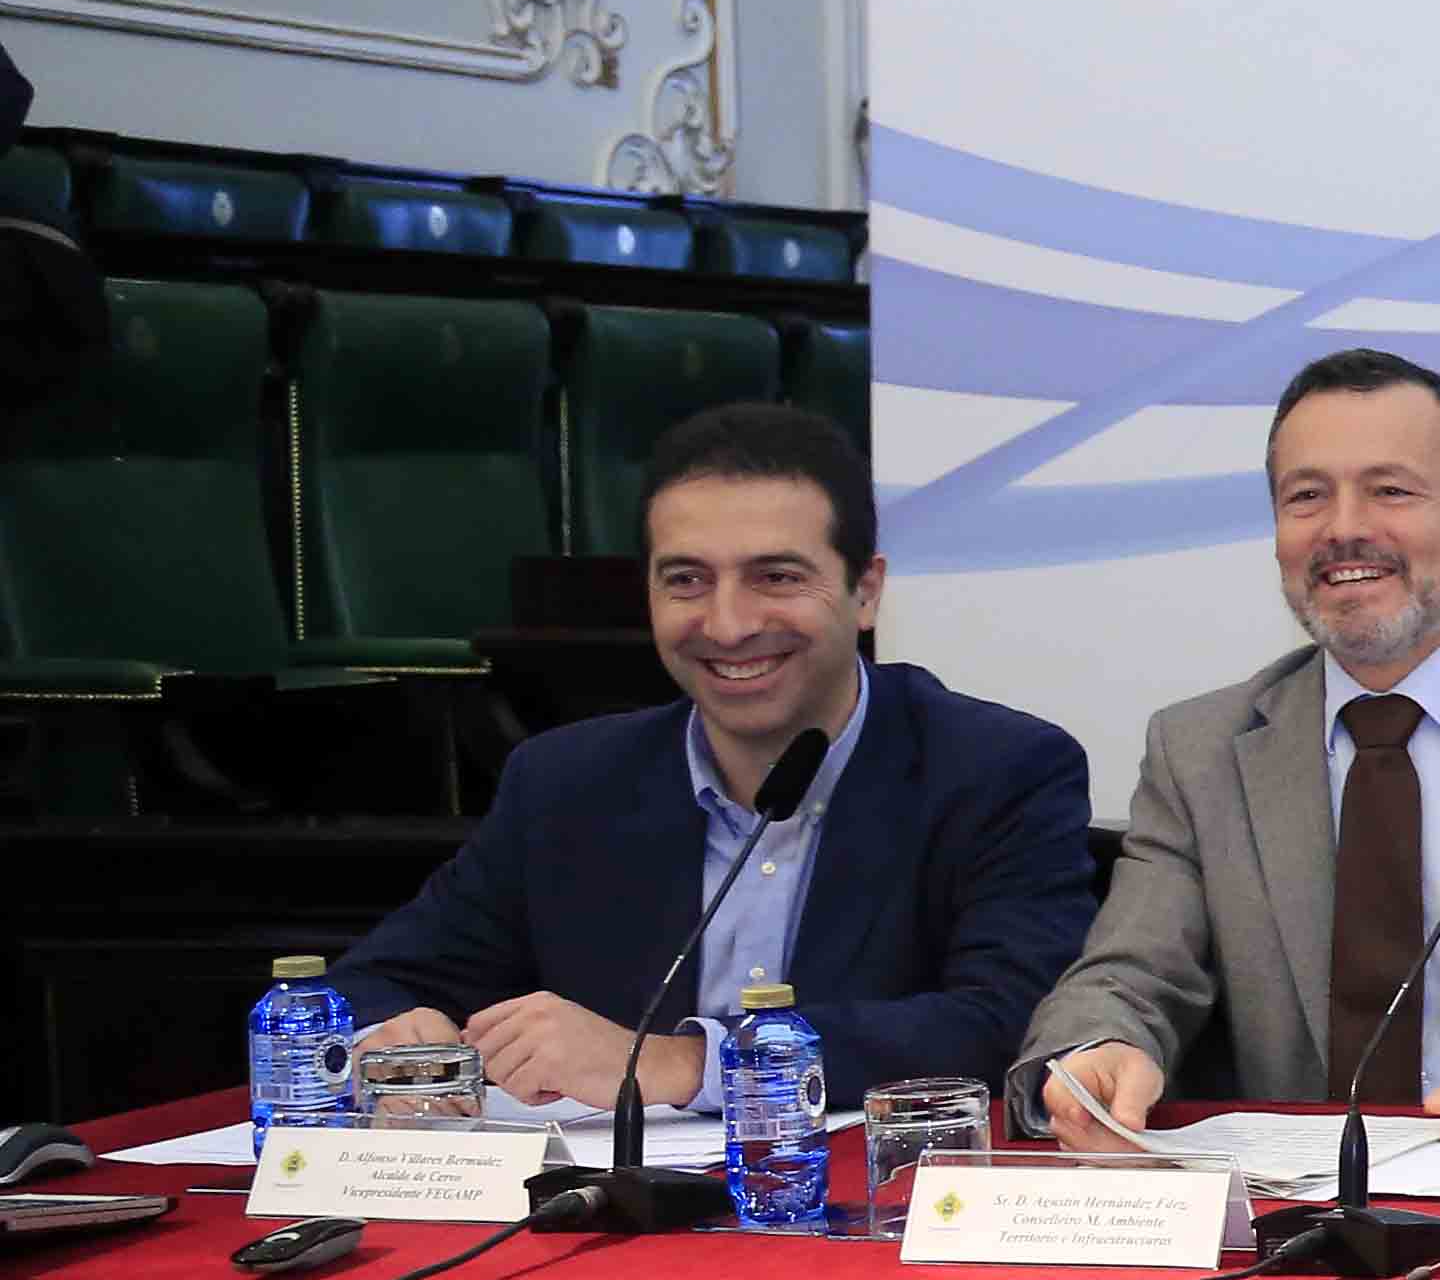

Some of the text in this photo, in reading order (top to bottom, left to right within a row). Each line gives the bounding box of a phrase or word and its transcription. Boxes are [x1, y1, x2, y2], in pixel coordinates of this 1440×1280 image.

[371, 1170, 410, 1181] Alcalde
[413, 1170, 426, 1181] de
[343, 1185, 483, 1201] Vicepresidente FEGAMP
